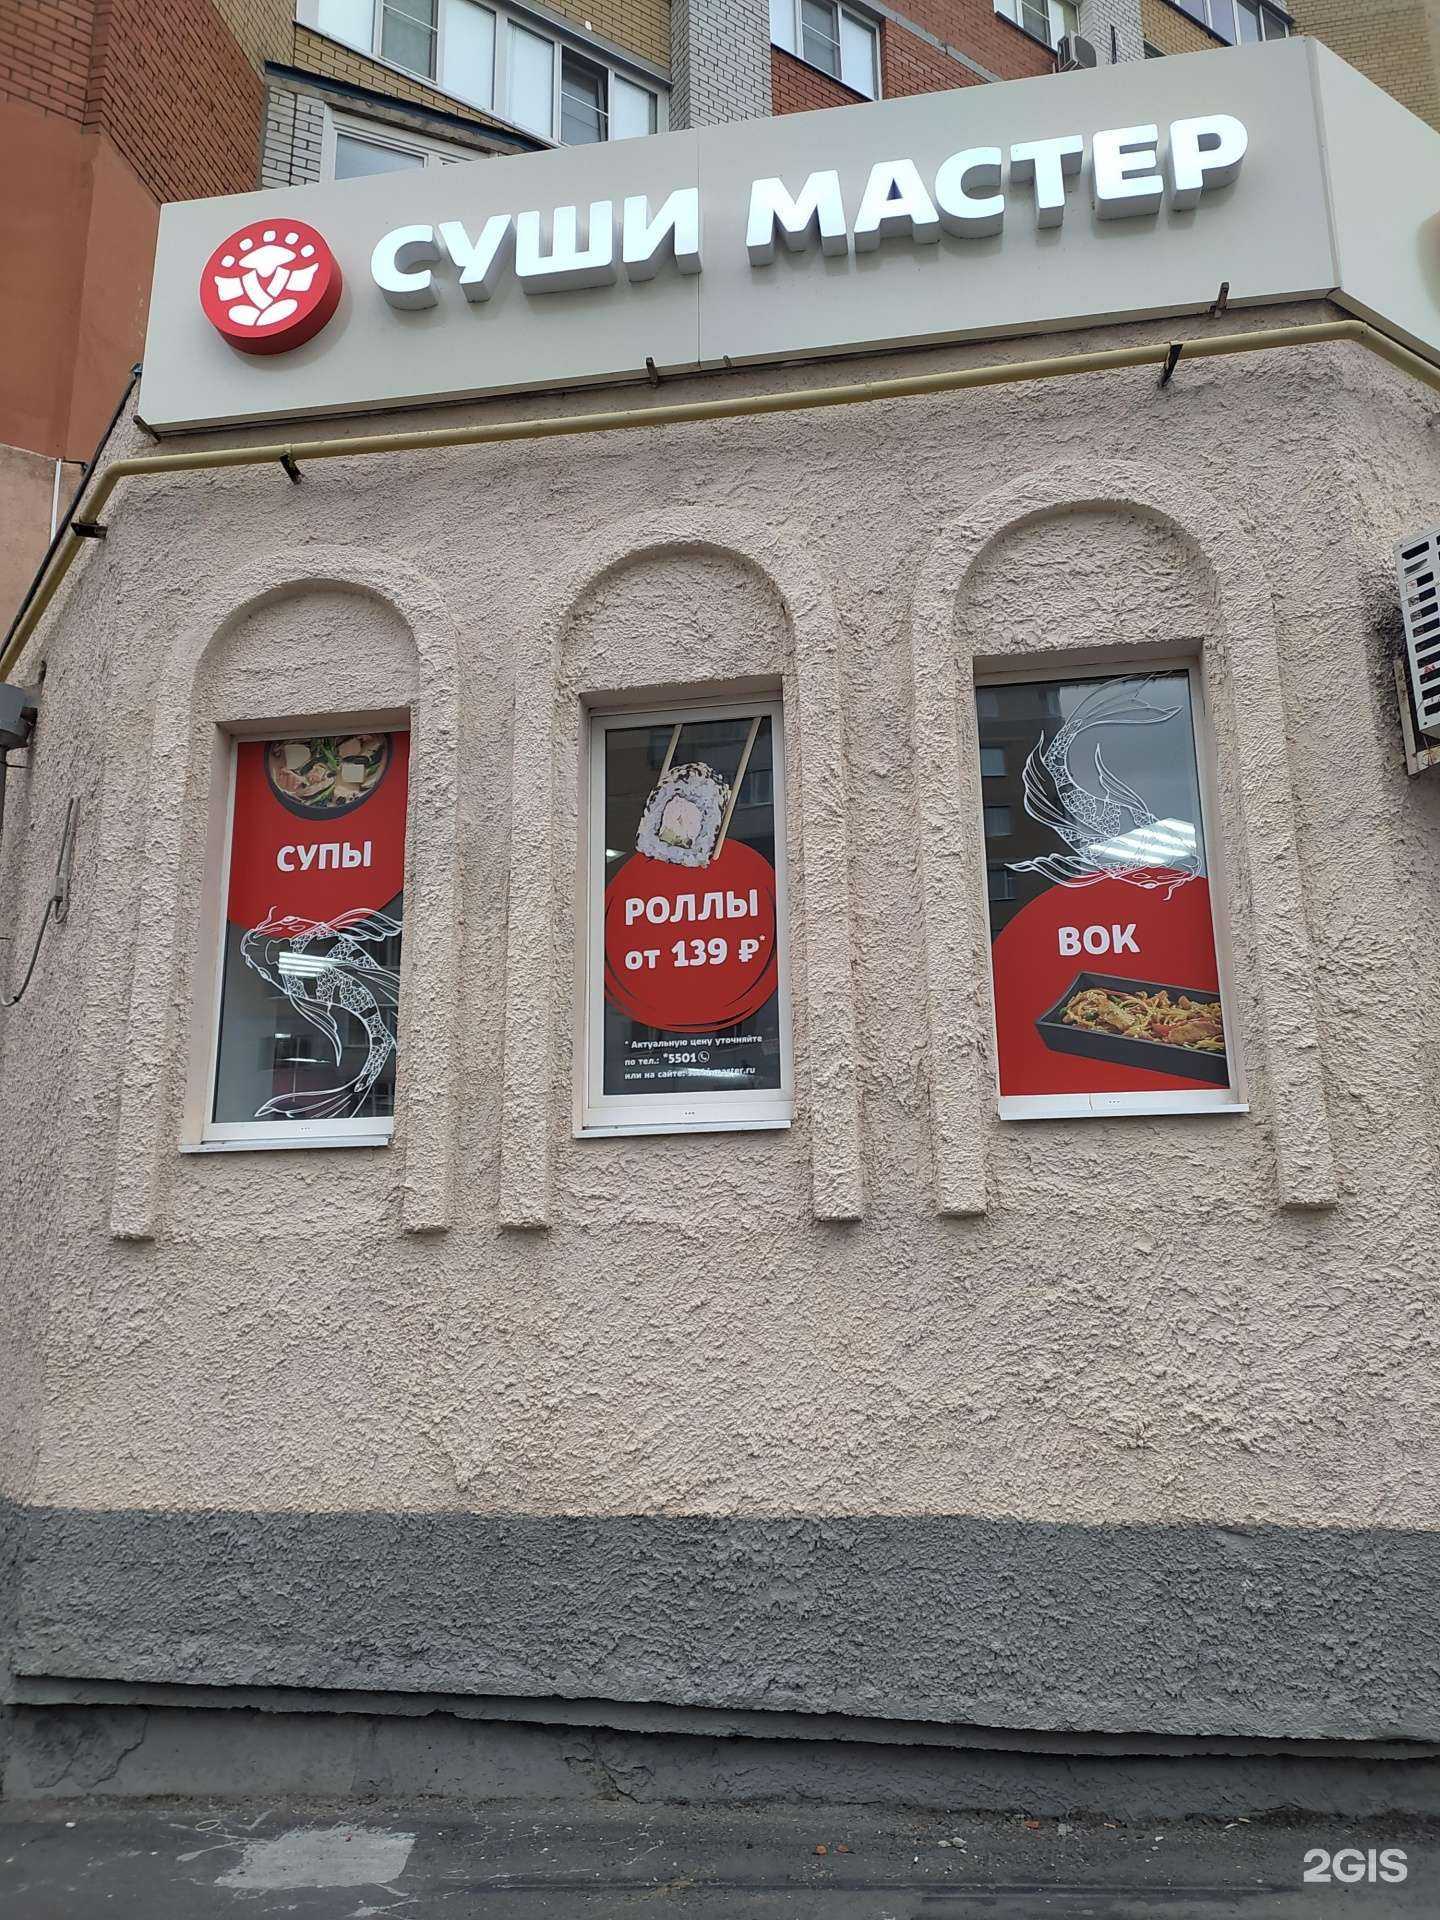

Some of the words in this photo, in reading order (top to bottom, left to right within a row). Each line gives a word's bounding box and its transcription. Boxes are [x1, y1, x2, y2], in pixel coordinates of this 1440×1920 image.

[370, 187, 700, 293] СУШИ
[745, 113, 1249, 248] МАСТЕР
[276, 840, 373, 873] СУПЫ
[625, 889, 758, 926] РОЛЛЫ
[625, 949, 660, 970] от
[671, 937, 728, 968] 139
[1057, 922, 1142, 957] ВОК
[630, 1039, 688, 1050] Актуальную
[690, 1037, 713, 1047] цену
[714, 1034, 763, 1046] уточняйте
[624, 1072, 642, 1080] или
[644, 1071, 655, 1079] на
